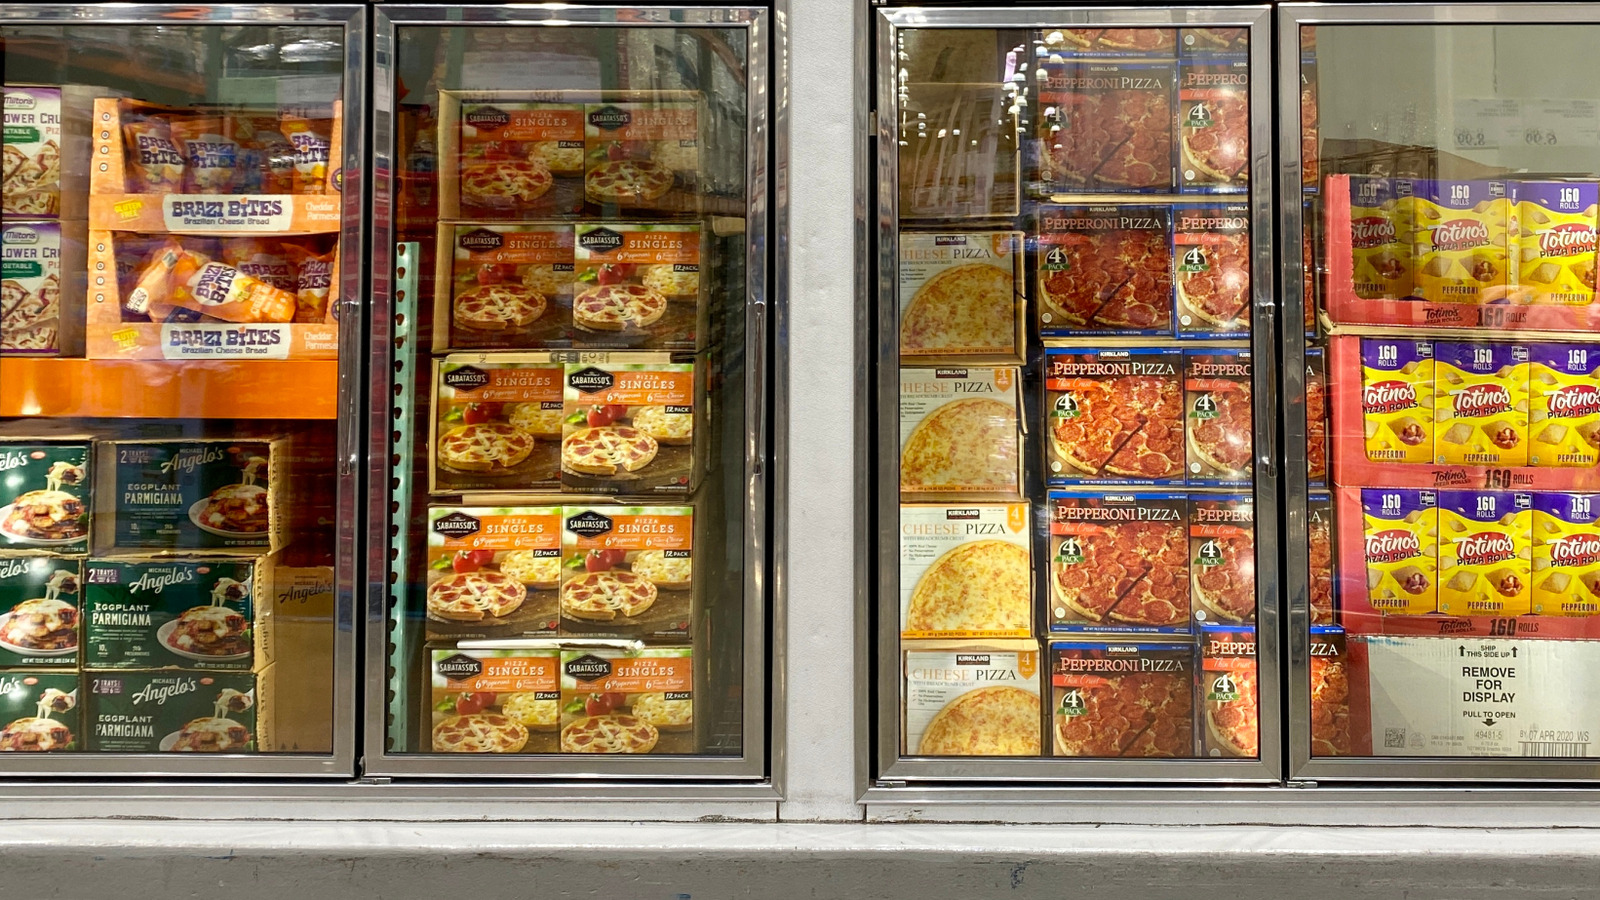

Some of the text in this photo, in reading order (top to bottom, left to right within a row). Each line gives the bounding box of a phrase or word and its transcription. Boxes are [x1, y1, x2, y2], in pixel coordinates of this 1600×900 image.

[1121, 78, 1163, 89] PIZZA
[1187, 73, 1247, 85] PEPPERO
[1192, 103, 1204, 119] 4
[1451, 185, 1469, 199] 160
[1560, 188, 1580, 203] 160
[172, 197, 282, 217] BRAZI BITES
[1560, 202, 1580, 210] ROLLS
[1121, 218, 1161, 229] PIZZA
[1427, 224, 1488, 246] Totino's
[954, 249, 991, 258] PIZZA
[1187, 248, 1200, 263] 4
[1442, 286, 1478, 294] PEPPERONI
[1551, 293, 1588, 301] PEPPERONI
[1423, 307, 1459, 319] Totino's
[170, 326, 280, 347] BRAZI BITES
[1378, 346, 1397, 360] 160
[1473, 349, 1493, 363] 160
[1568, 349, 1587, 364] 160
[1053, 362, 1175, 375] PEPPERONI PIZZA
[1567, 363, 1587, 371] ROLLS
[619, 380, 675, 389] SINGLES
[955, 382, 993, 392] PIZZA
[1056, 377, 1072, 387] Thin
[1195, 379, 1211, 389] Thin
[607, 392, 613, 402] 6
[1058, 393, 1069, 409] 4
[1197, 394, 1209, 410] 4
[1449, 386, 1511, 409] Totino's
[121, 451, 126, 463] 2
[161, 447, 223, 473] Angelo's
[1370, 451, 1406, 459] PEPPERONI
[1464, 454, 1500, 462] PEPPERONI
[1558, 454, 1594, 463] PEPPERONI
[125, 493, 182, 504] PARMIGIANA
[1382, 494, 1401, 509] 160
[1476, 496, 1496, 510] 160
[1571, 498, 1590, 512] 160
[1058, 506, 1181, 520] PEPPERONI PIZZA
[1476, 510, 1495, 518] ROLLS
[1571, 512, 1590, 520] ROLLS
[437, 521, 477, 531] SABATASSO'S
[486, 524, 544, 534] SINGLES
[570, 520, 609, 529] SABATASSO'S
[618, 524, 675, 533] SINGLES
[903, 524, 1005, 534] CHEESE PIZZA
[1060, 522, 1076, 532] Thin
[473, 536, 479, 546] 6
[605, 536, 611, 546] 6
[1062, 538, 1075, 555] 4
[1452, 535, 1515, 557] Totino's
[1202, 540, 1215, 557] 4
[1486, 552, 1516, 562] ROLLS
[1551, 558, 1579, 567] PIZZA
[89, 569, 95, 582] 2
[129, 567, 192, 594] Angelo's
[278, 581, 333, 603] Angelo's
[96, 604, 151, 612] EGGPLANT
[1373, 600, 1410, 608] PEPPERONI
[1467, 602, 1504, 610] PEPPERONI
[1561, 603, 1598, 611] PEPPERONI
[92, 613, 151, 625] PARMIGIANA
[1489, 619, 1539, 636] 160 ROLLS
[1210, 640, 1255, 655] PEPPE
[439, 663, 479, 672] SABATASSO'S
[569, 664, 609, 673] SABATASSO'S
[1060, 657, 1184, 672] PEPPERONI PIZZA
[1212, 658, 1229, 668] Thin
[488, 667, 544, 676] SINGLES
[617, 667, 674, 676] SINGLES
[913, 669, 1016, 680] CHEESE PIZZA
[1462, 667, 1515, 678] REMOVE
[93, 680, 99, 692] 2
[476, 679, 481, 689] 6
[1217, 675, 1229, 692] 4
[1476, 680, 1502, 690] FOR
[132, 677, 196, 705] Angelo's
[1065, 691, 1077, 707] 4
[1463, 692, 1515, 703] DISPLAY
[95, 724, 154, 738] PARMIGIANA
[1475, 731, 1502, 739] 49481-5
[1529, 731, 1537, 741] 07
[1539, 731, 1555, 741] APR
[1557, 731, 1574, 741] 2020
[1577, 731, 1589, 741] WS
